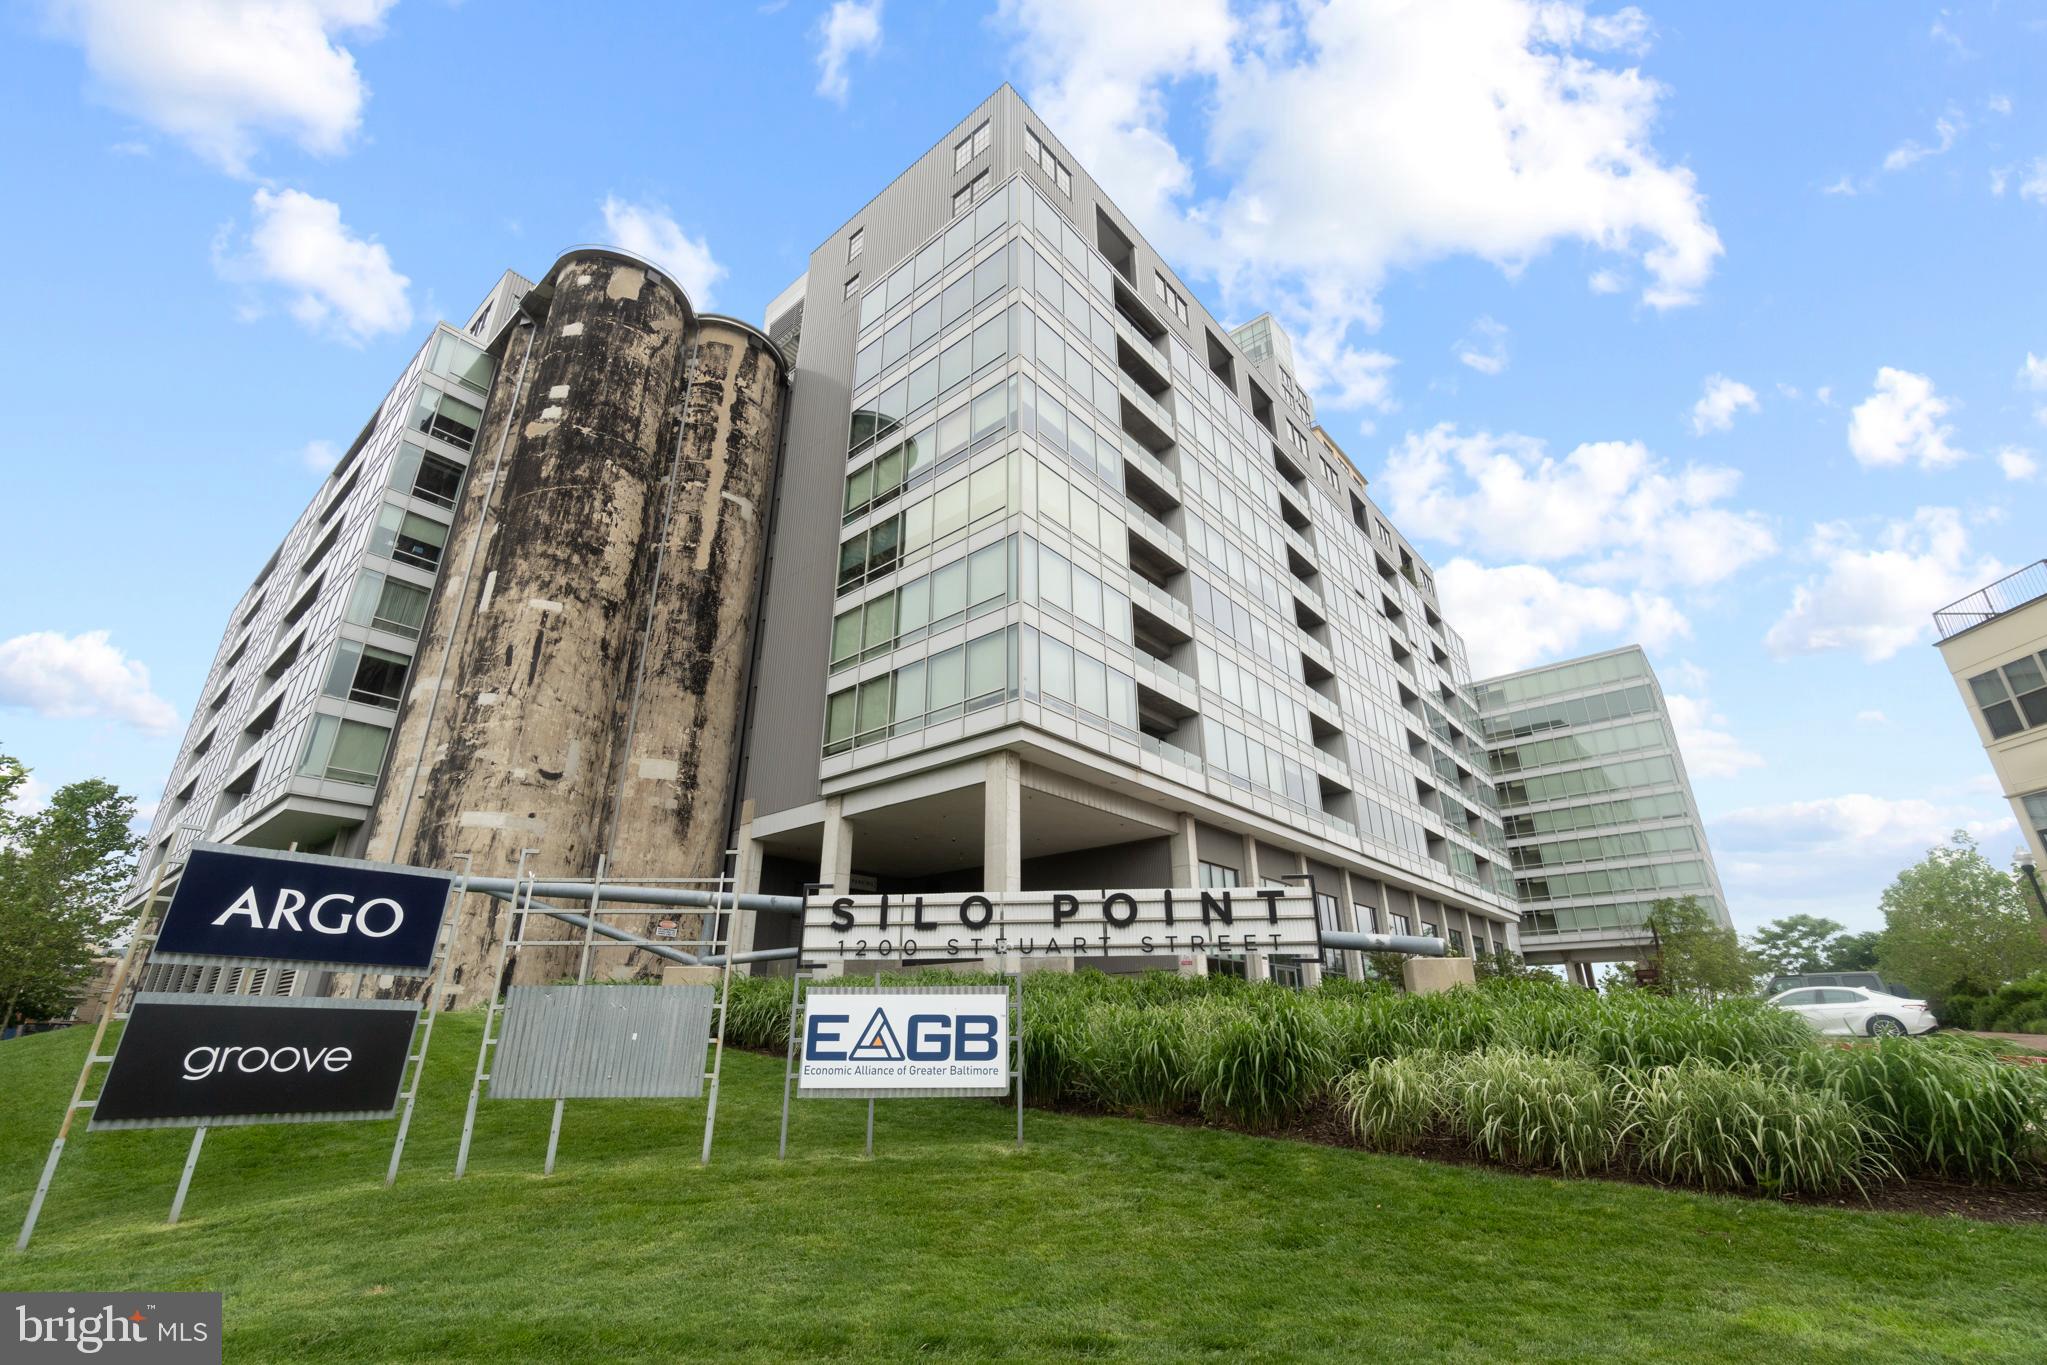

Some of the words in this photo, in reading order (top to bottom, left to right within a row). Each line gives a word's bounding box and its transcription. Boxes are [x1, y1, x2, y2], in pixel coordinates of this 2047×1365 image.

[211, 885, 404, 938] ARGO
[831, 894, 993, 931] SILO
[1053, 889, 1285, 928] POINT
[838, 939, 917, 956] 1200
[1141, 934, 1281, 953] STREET
[805, 1006, 999, 1062] EAGB
[182, 1046, 352, 1080] groove
[804, 1065, 852, 1076] Economic
[854, 1065, 895, 1076] Alliance
[897, 1065, 907, 1076] of
[909, 1065, 947, 1076] Greater
[950, 1065, 999, 1076] Baltimore
